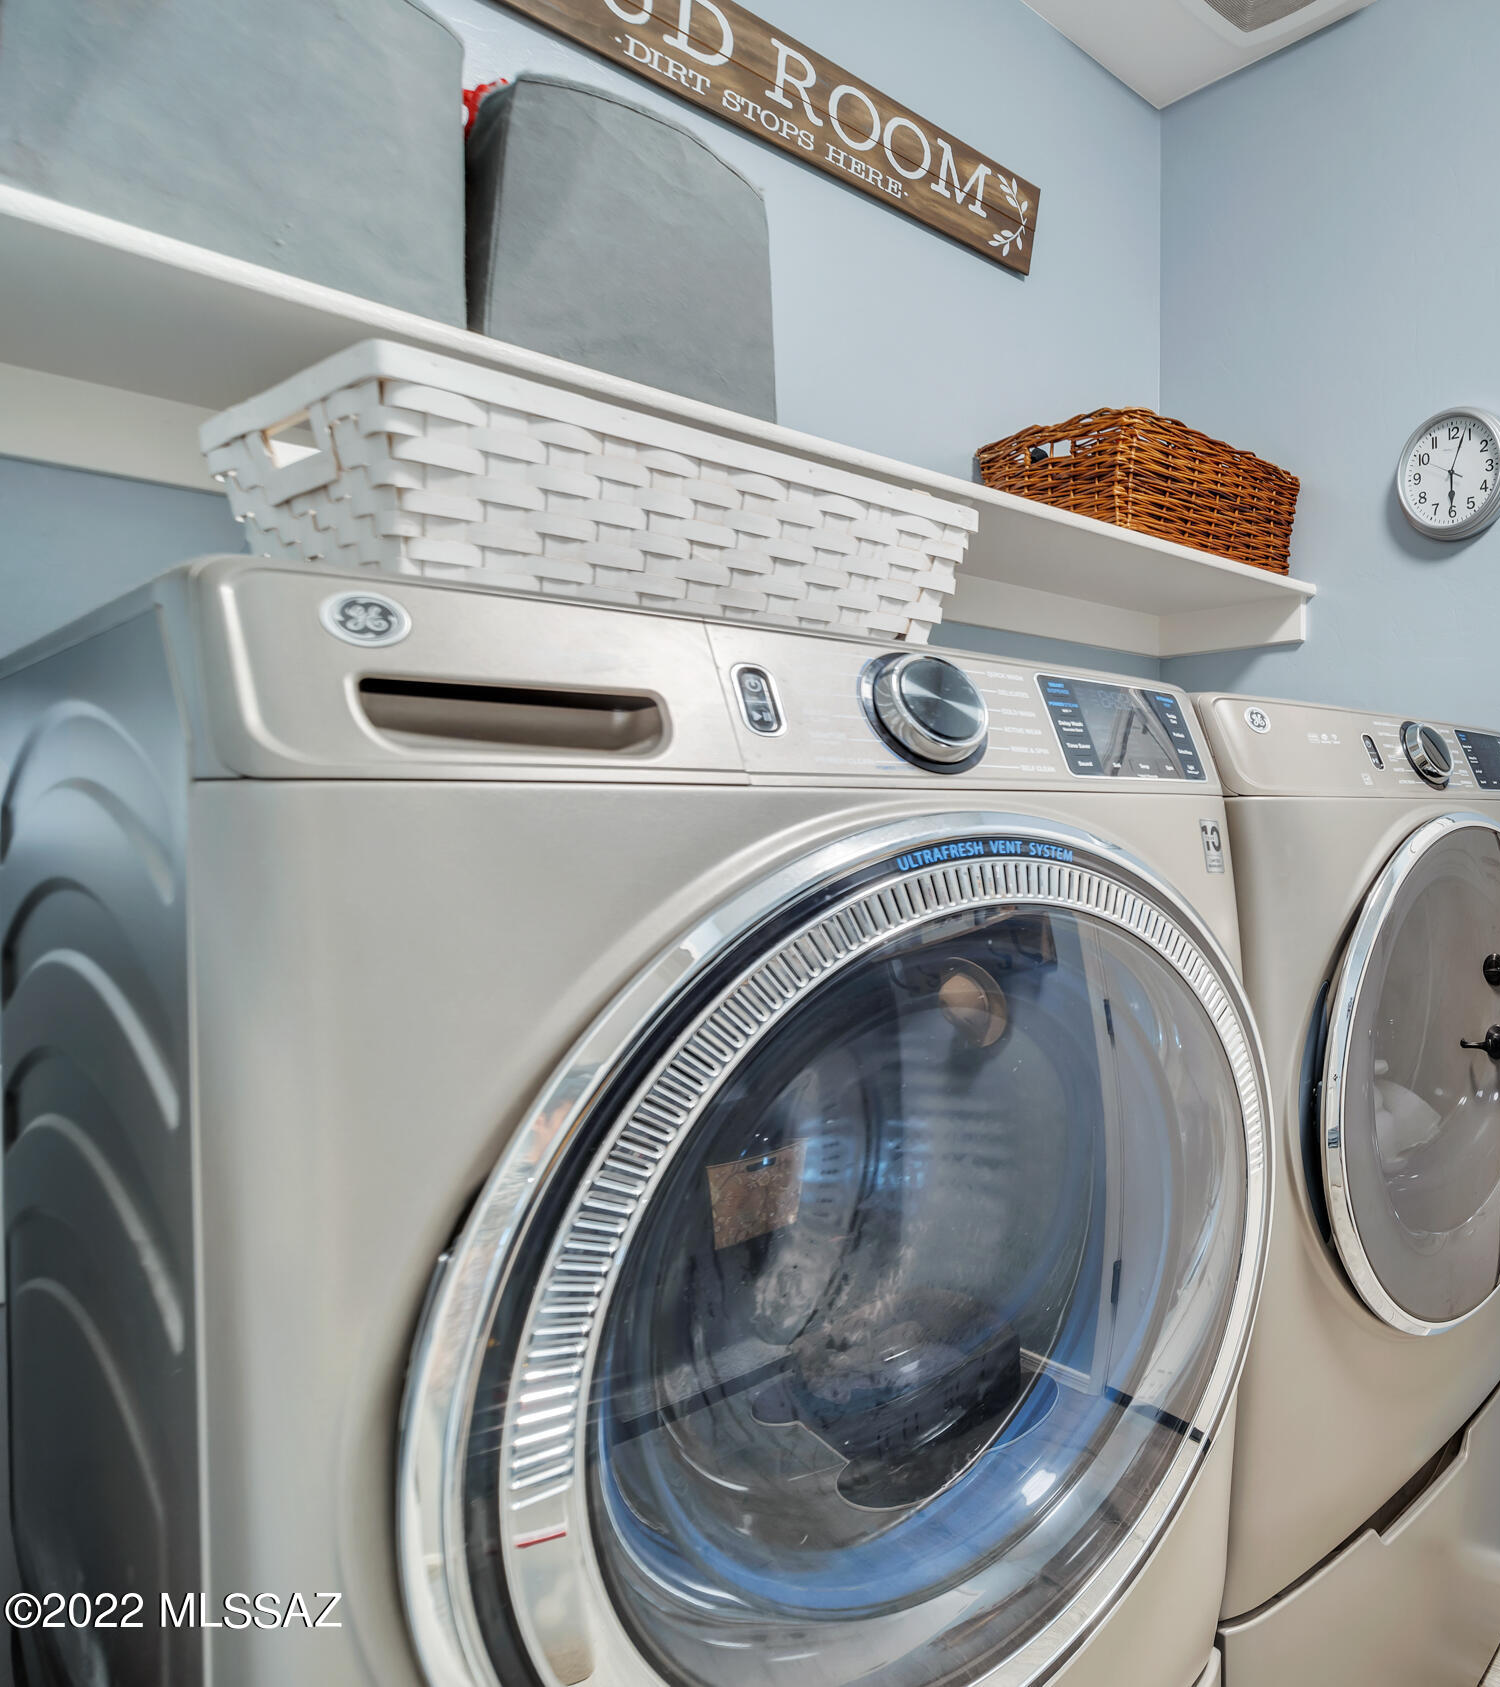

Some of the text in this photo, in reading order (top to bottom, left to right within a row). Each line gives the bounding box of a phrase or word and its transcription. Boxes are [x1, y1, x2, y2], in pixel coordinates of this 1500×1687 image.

[721, 89, 815, 151] STOPS
[764, 37, 992, 220] ROOM
[1448, 426, 1460, 441] 12
[1431, 436, 1438, 449] 11
[1479, 439, 1489, 453] 2
[1418, 453, 1430, 466] 10
[1485, 458, 1494, 472] 3
[1413, 472, 1421, 485] 9
[1479, 479, 1489, 492] 4
[1418, 491, 1427, 504] 8
[1466, 496, 1475, 509] 5
[1431, 503, 1440, 516] 7
[1448, 505, 1457, 518] 6
[896, 840, 1073, 871] ULTRAFRESH VENT SYSTEM
